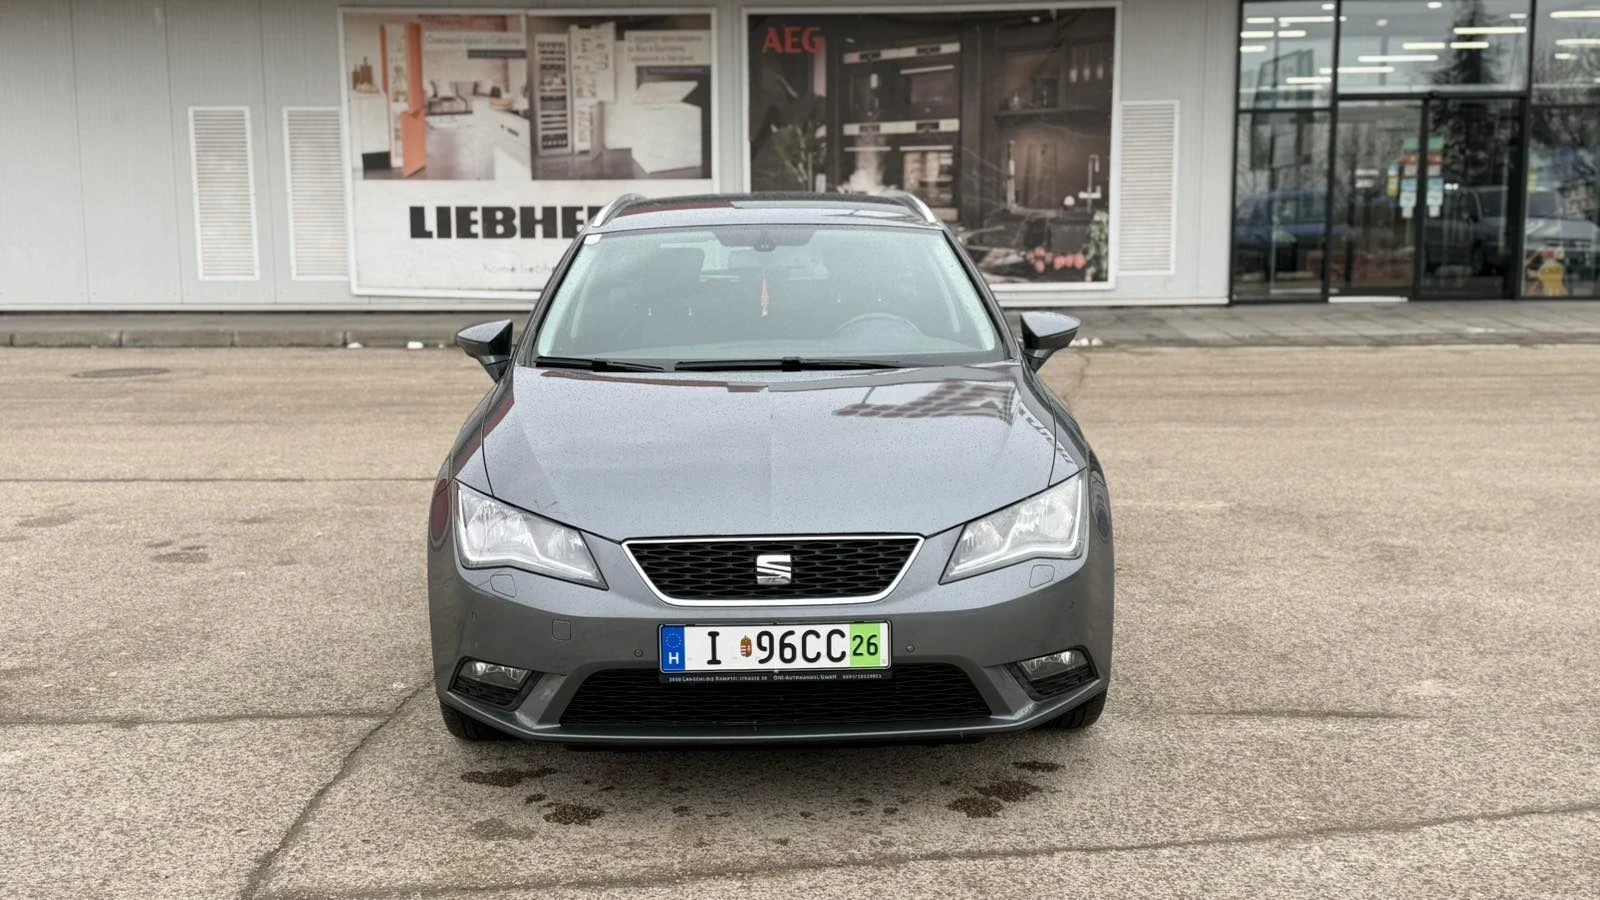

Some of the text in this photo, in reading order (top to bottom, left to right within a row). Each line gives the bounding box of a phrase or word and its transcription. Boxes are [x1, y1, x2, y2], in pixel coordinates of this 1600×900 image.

[763, 26, 824, 54] AEG
[669, 651, 679, 665] H
[707, 629, 879, 665] I 96CC 26
